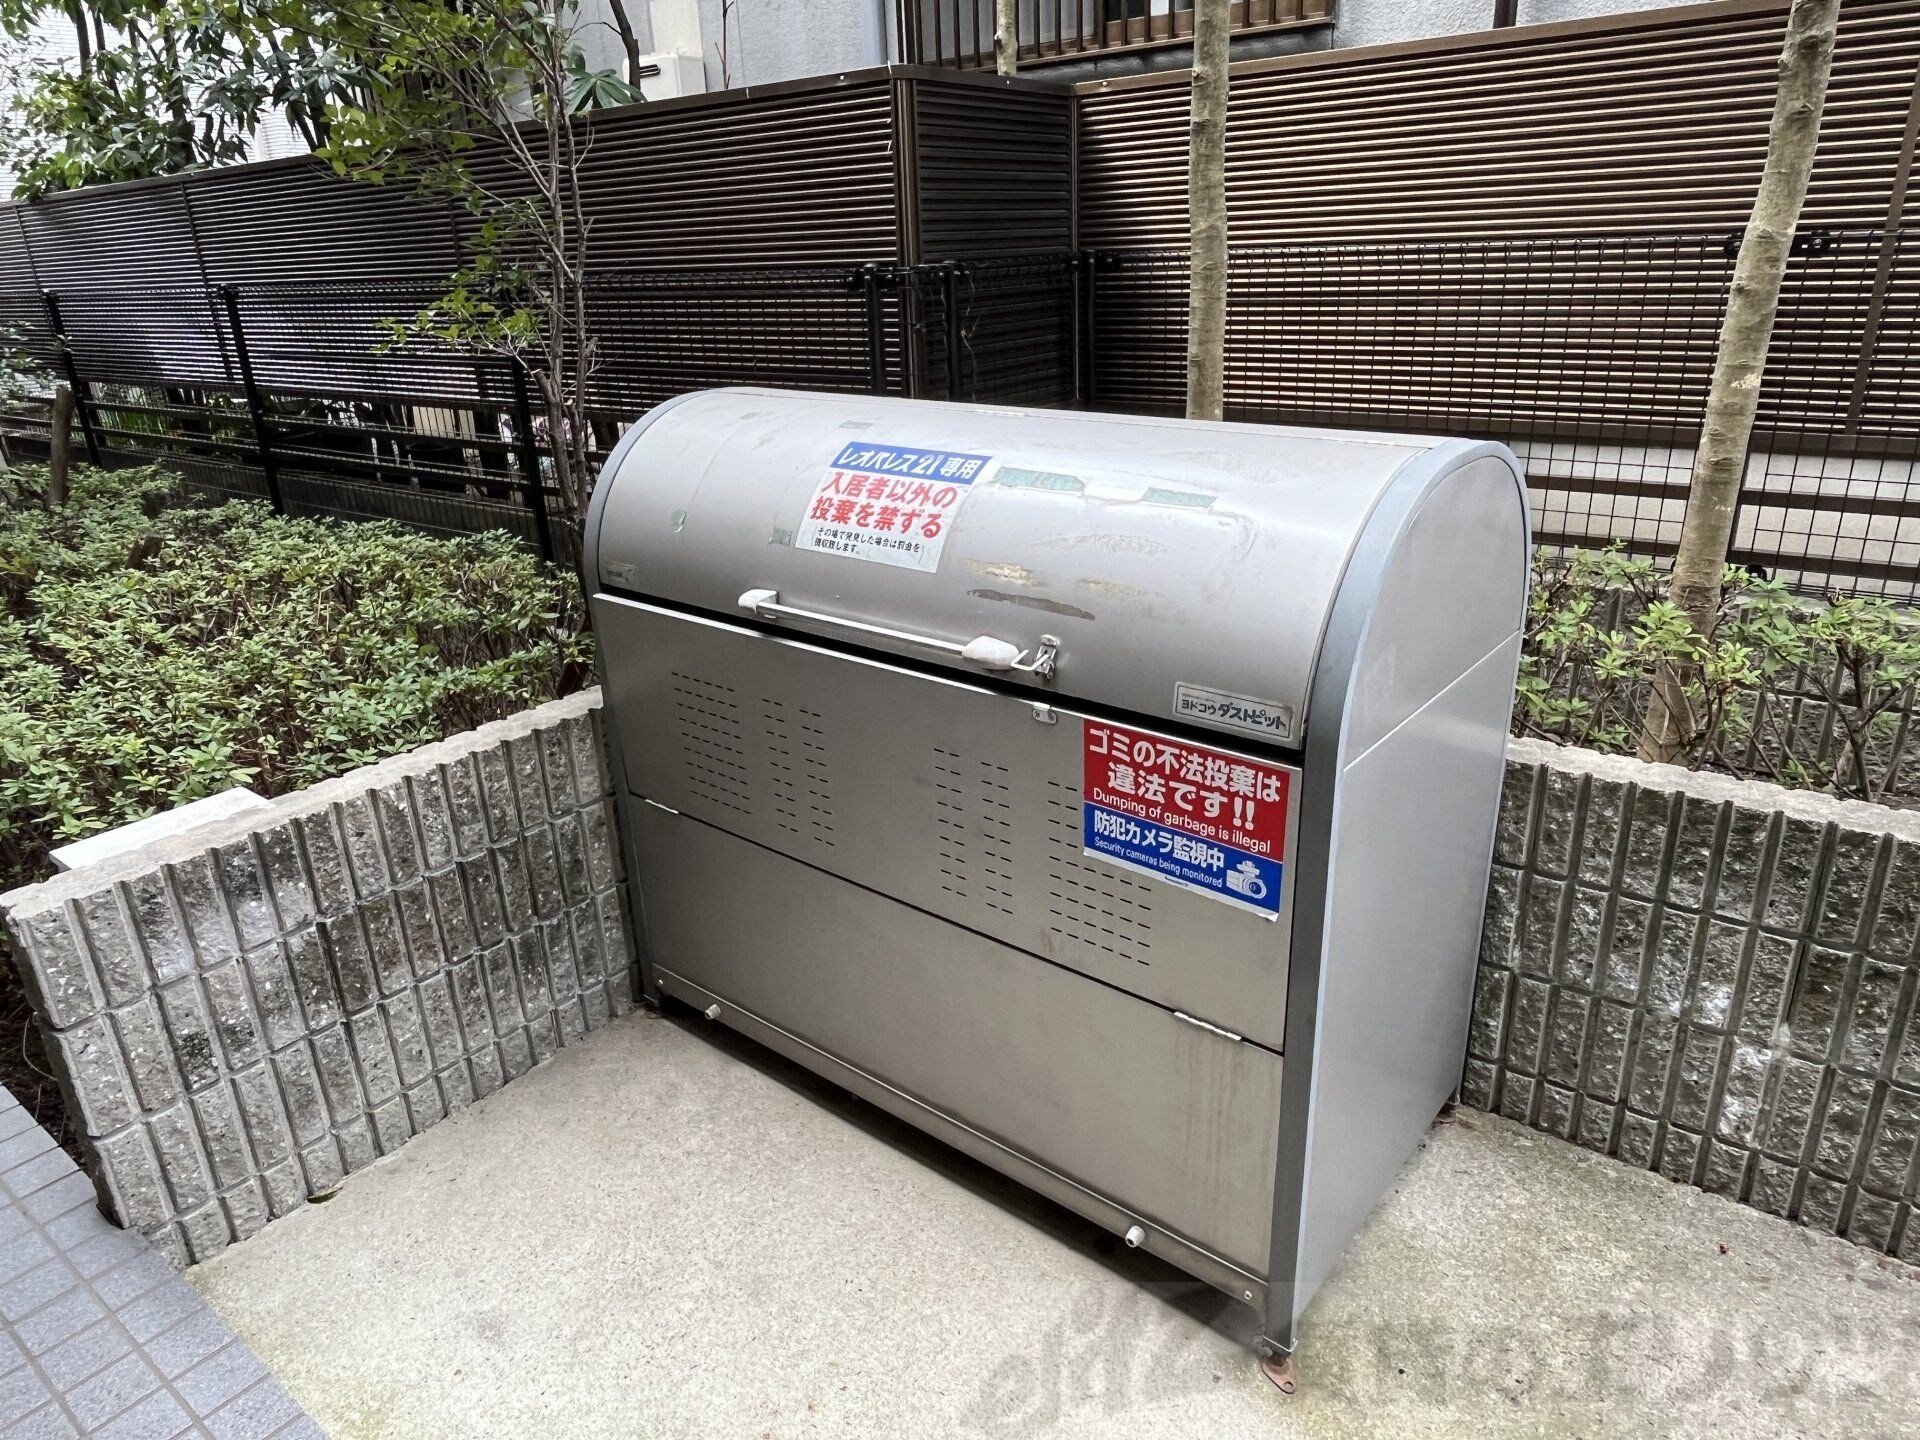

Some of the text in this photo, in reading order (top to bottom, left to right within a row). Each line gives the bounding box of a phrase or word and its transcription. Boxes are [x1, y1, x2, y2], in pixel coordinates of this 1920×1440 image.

[810, 495, 943, 539] 投棄を禁ずる
[821, 471, 958, 509] 入居者以外の
[1089, 728, 1281, 803] ゴミの不法投棄は
[1107, 761, 1254, 831] 違法です!!
[1093, 788, 1271, 854] Dumping of garbage is illegal
[1094, 809, 1225, 872] 防犯カメラ監視中
[1095, 836, 1125, 856] Security
[1159, 857, 1181, 876] being
[1181, 867, 1223, 888] monitored
